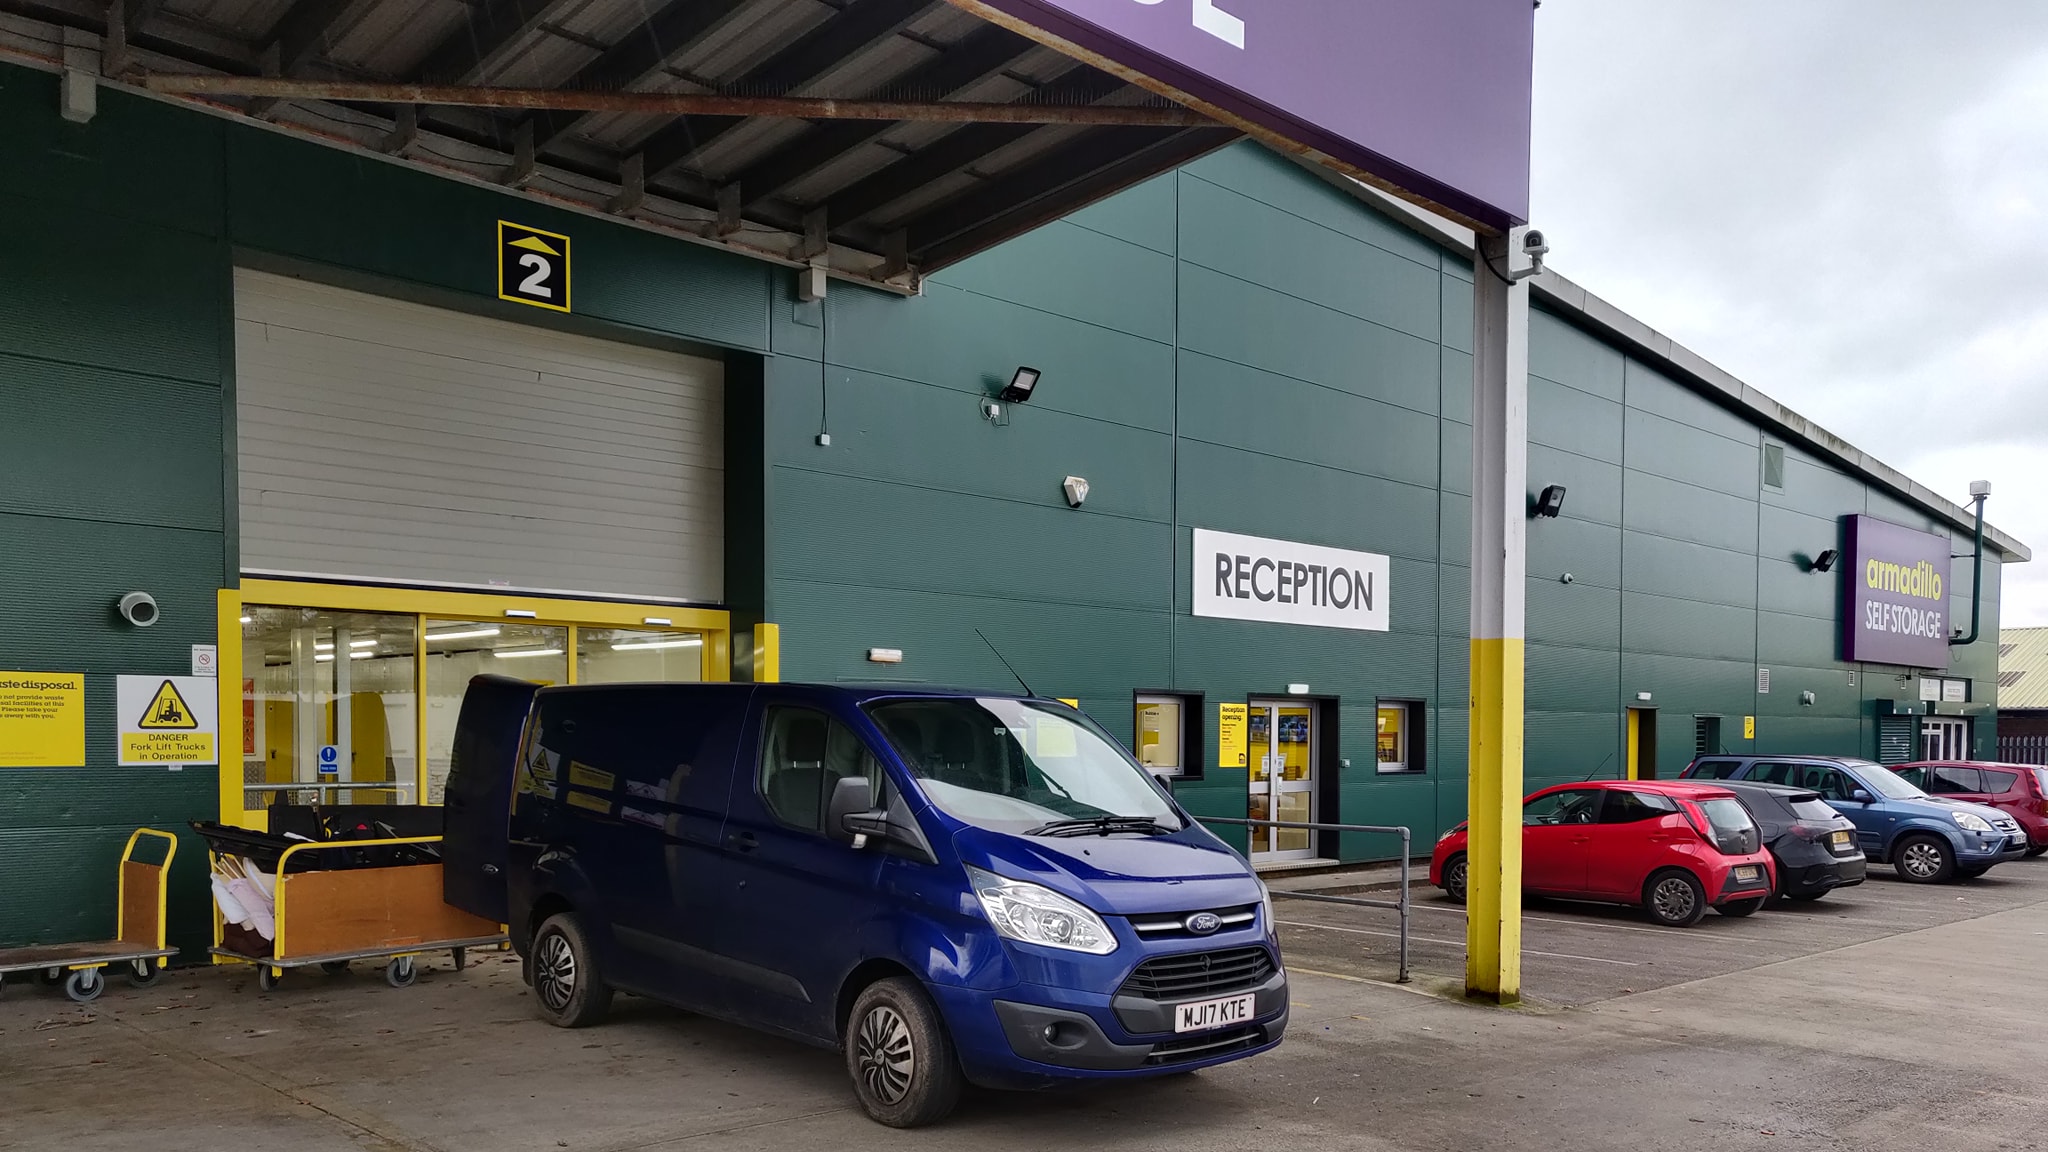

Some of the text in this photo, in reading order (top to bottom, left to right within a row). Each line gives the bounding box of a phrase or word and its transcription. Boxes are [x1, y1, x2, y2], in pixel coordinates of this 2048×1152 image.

[518, 253, 552, 299] 2
[1215, 552, 1373, 611] RECEPTION
[1866, 558, 1942, 601] armadillo
[1865, 599, 1941, 638] SELF STORAGE
[21, 680, 78, 691] disposal.
[130, 743, 206, 751] Fork Lift Trucks
[148, 733, 189, 741] DANGER
[139, 752, 198, 761] in Operation
[1196, 916, 1216, 930] Ford
[1183, 998, 1247, 1029] MJ17 KTE
